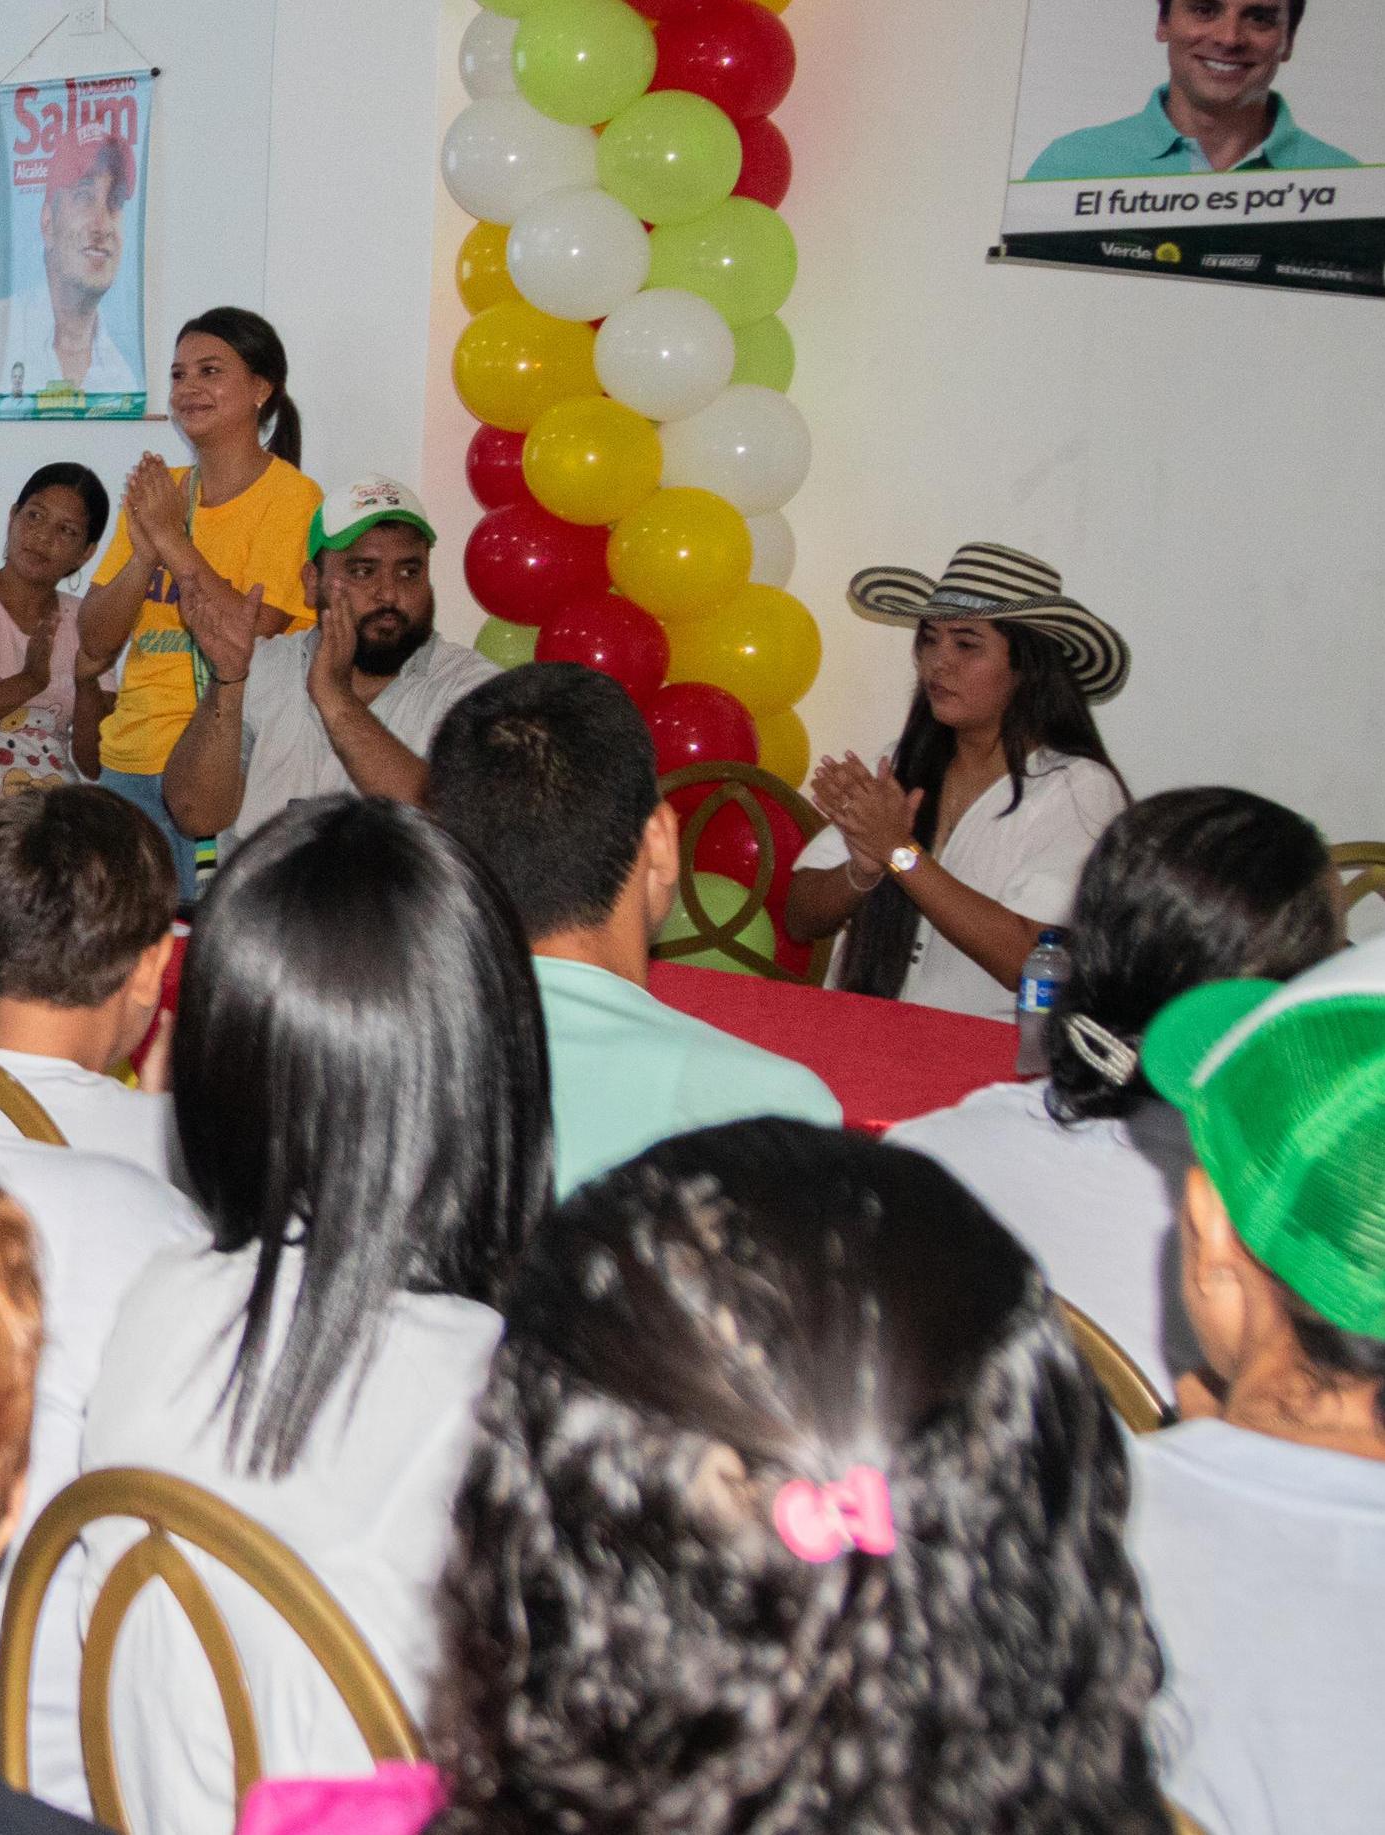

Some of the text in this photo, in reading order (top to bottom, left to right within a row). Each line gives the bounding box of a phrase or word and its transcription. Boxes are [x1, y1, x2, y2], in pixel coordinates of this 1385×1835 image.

[13, 78, 138, 154] Salim
[1075, 190, 1102, 216] El
[1108, 189, 1200, 214] futuro
[1206, 191, 1239, 210] es
[1299, 186, 1336, 213] ya
[1101, 241, 1152, 260] Verde
